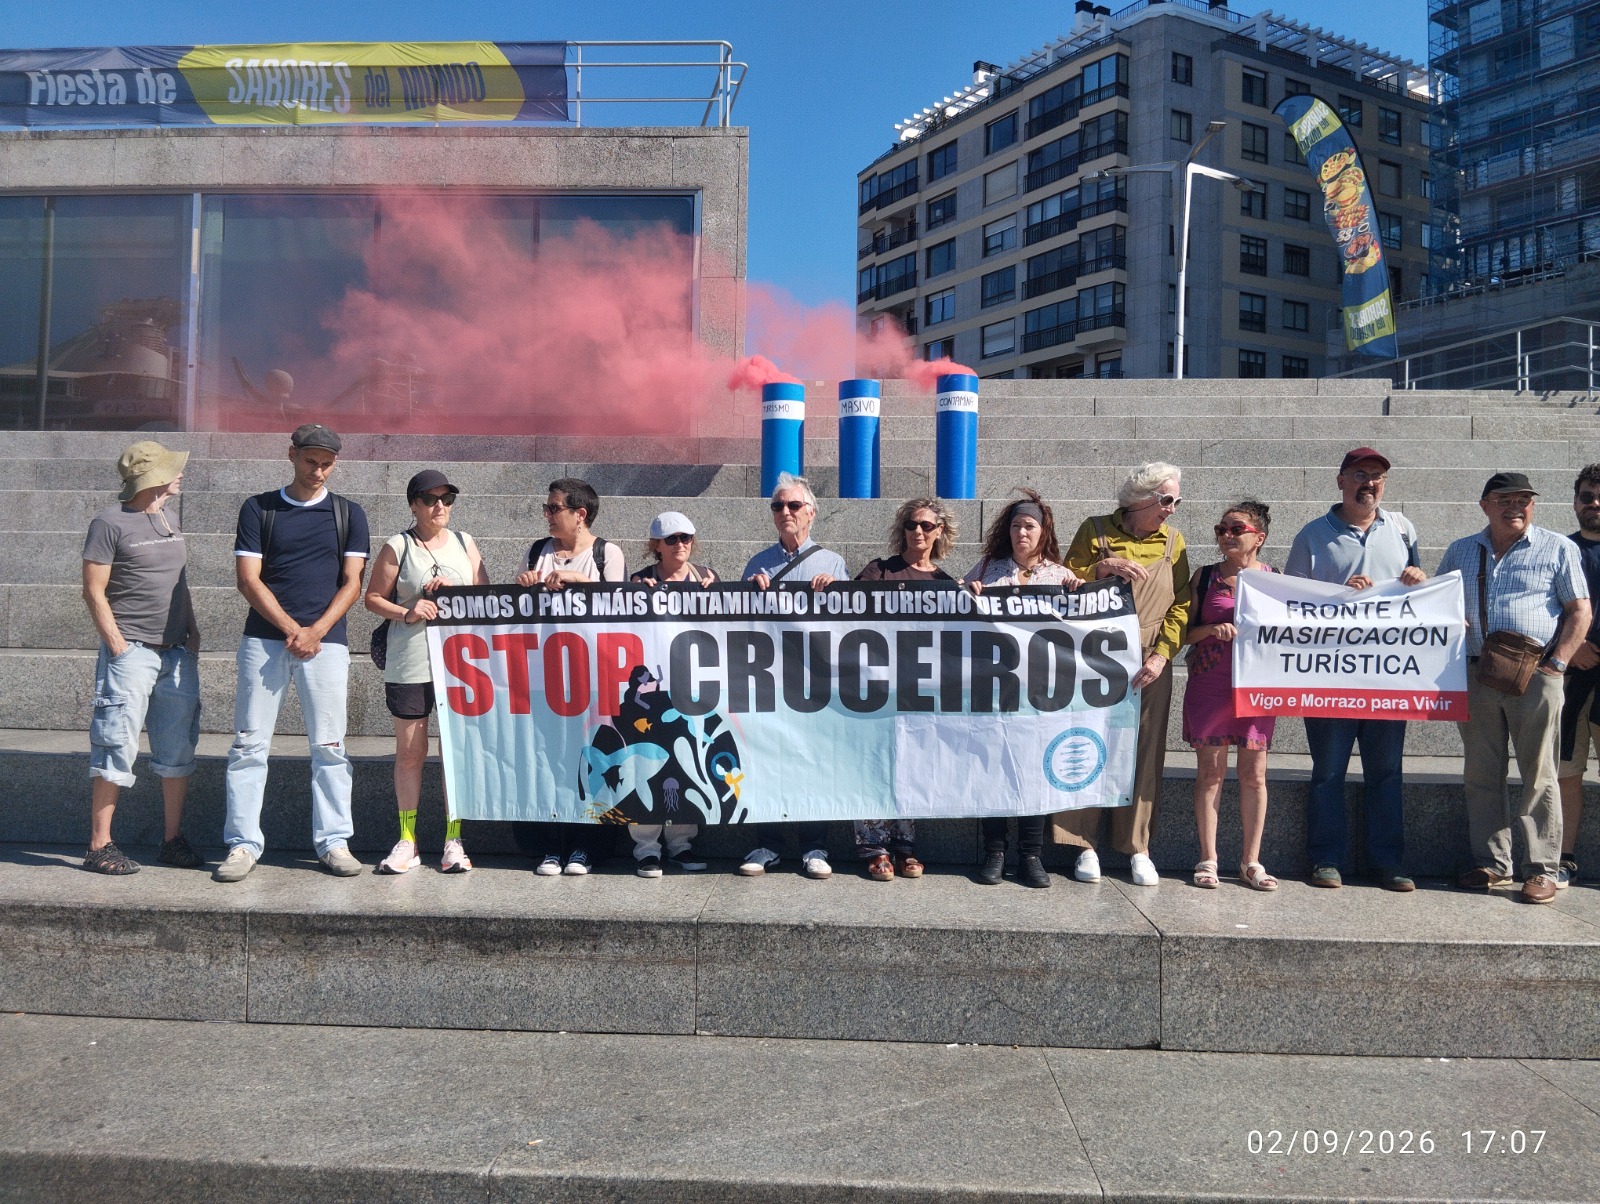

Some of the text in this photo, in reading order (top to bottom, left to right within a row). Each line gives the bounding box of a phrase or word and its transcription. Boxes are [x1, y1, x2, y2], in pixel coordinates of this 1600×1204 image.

[25, 68, 177, 105] Fiesta de
[224, 58, 486, 114] SABORES del MUNDO
[841, 400, 875, 414] MASIVO
[437, 586, 1124, 619] SOMOS O PAÍS MÁIS CONTAMINADO POLO TURISMO DE CRUCEIROS
[1286, 596, 1418, 620] FRONTE Á
[1257, 622, 1448, 647] MASIFICACIÓN
[442, 628, 1129, 717] STOP CRUCEIROS
[1280, 649, 1421, 676] TURÍSTICA
[1249, 693, 1452, 712] Vigo e Morrazo para Vivir
